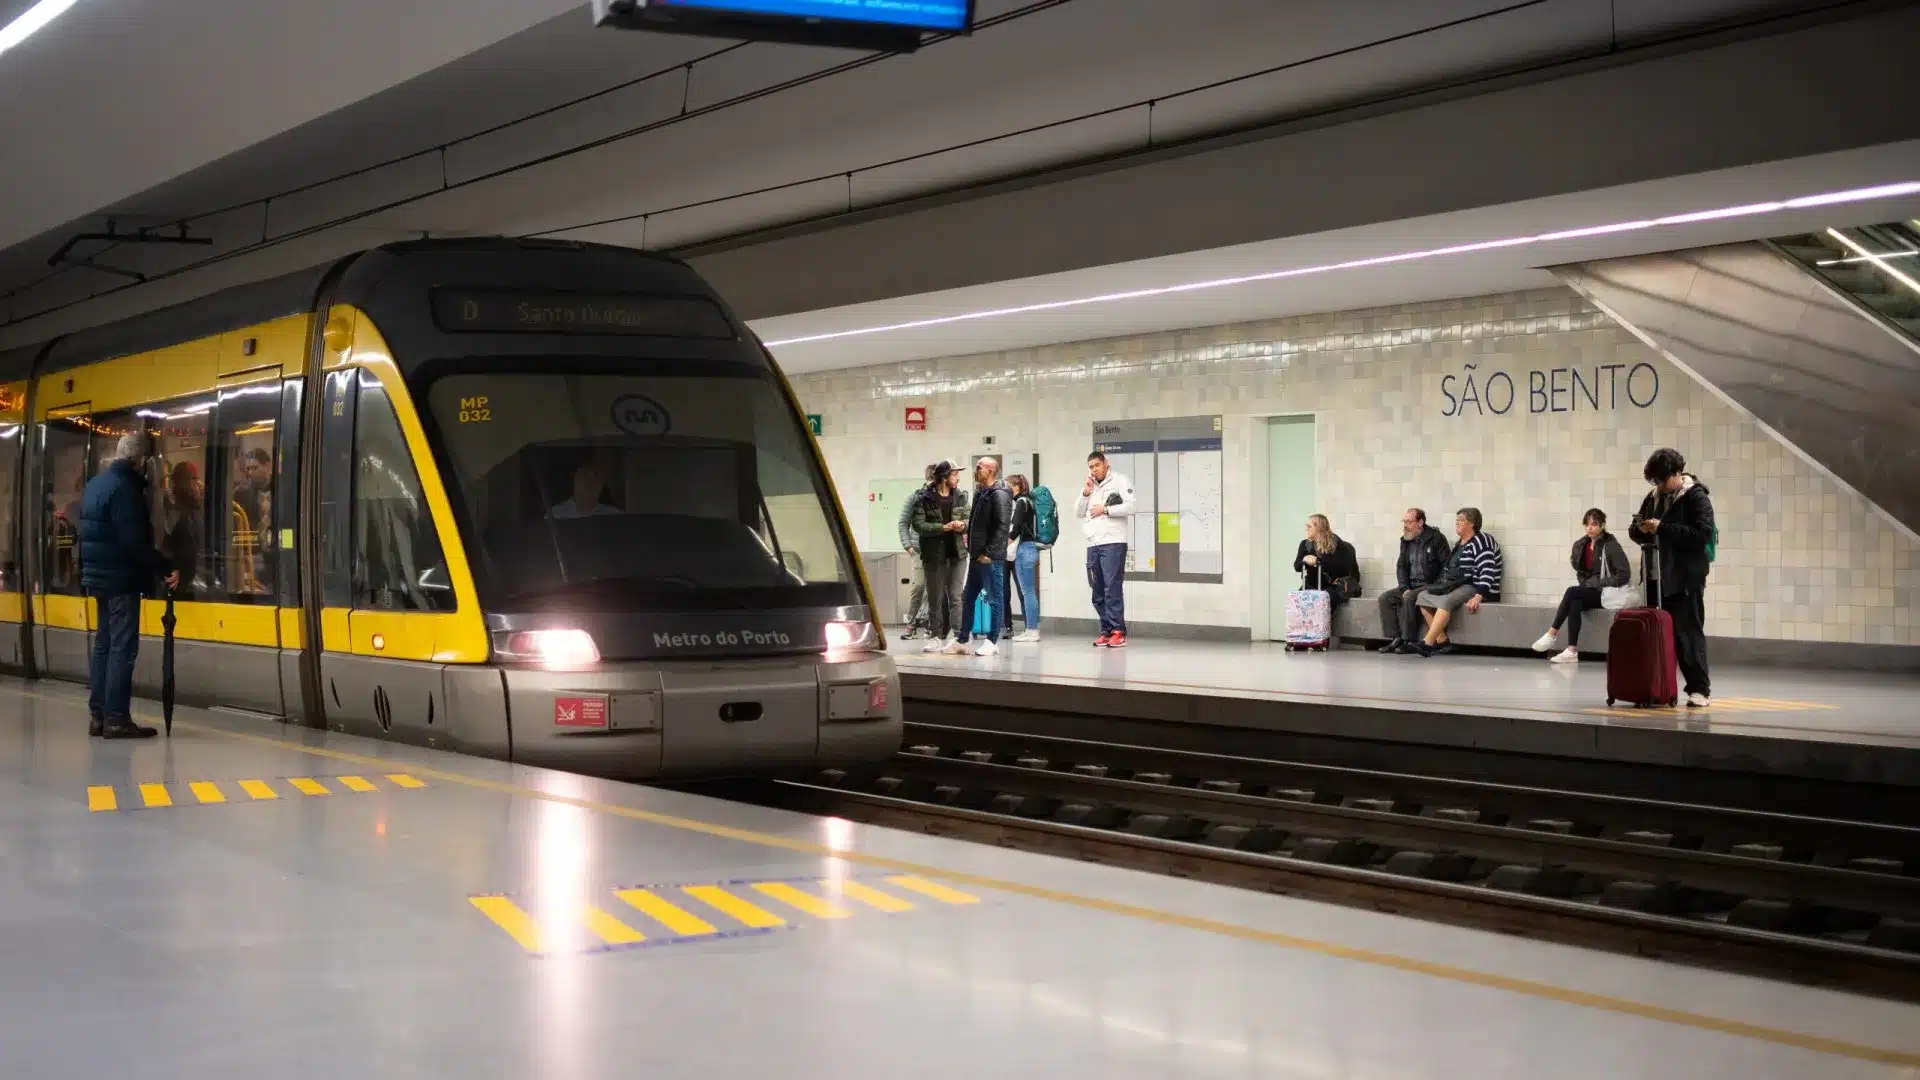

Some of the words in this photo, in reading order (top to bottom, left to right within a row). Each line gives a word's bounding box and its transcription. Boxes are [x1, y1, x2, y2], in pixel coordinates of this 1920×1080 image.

[1441, 363, 1514, 417] SÃO
[1529, 362, 1659, 414] BENTO
[460, 396, 489, 409] MP
[459, 409, 492, 423] 032
[653, 632, 711, 648] Metro
[716, 631, 738, 645] do
[741, 630, 790, 645] Porto
